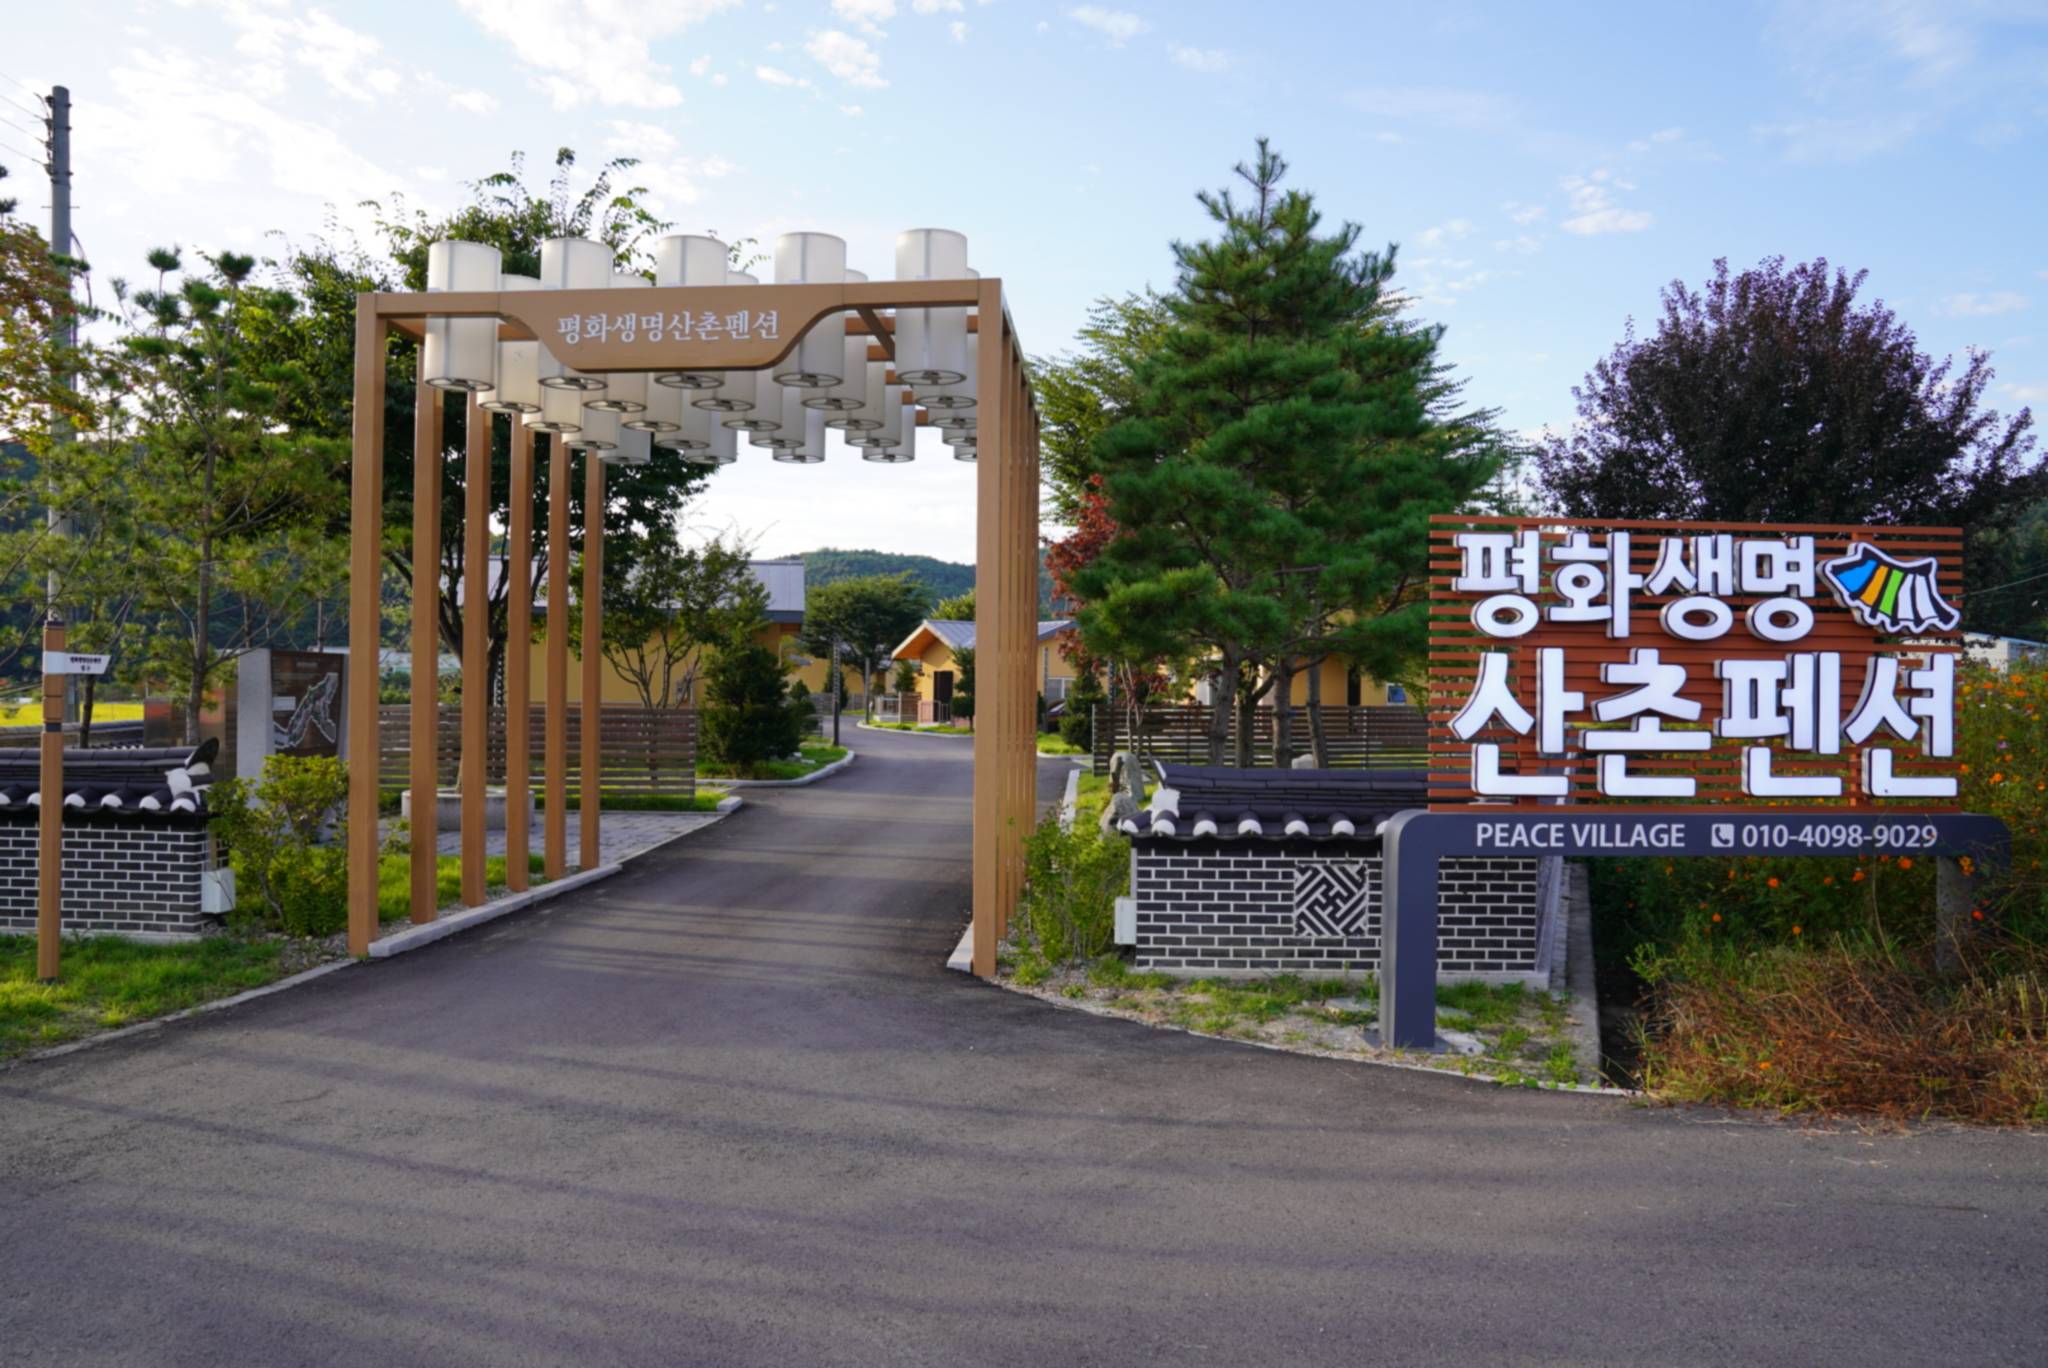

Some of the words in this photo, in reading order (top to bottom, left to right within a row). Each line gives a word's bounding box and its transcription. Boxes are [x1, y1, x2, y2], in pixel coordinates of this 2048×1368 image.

[557, 310, 780, 345] 평화생명산촌펜션
[1452, 530, 1816, 642] 평화생명
[1448, 648, 1958, 798] 산촌펜션
[1476, 822, 1565, 848] PEACE
[1571, 823, 1686, 848] VILLAGE
[1742, 824, 1938, 848] 010-4098-9029
